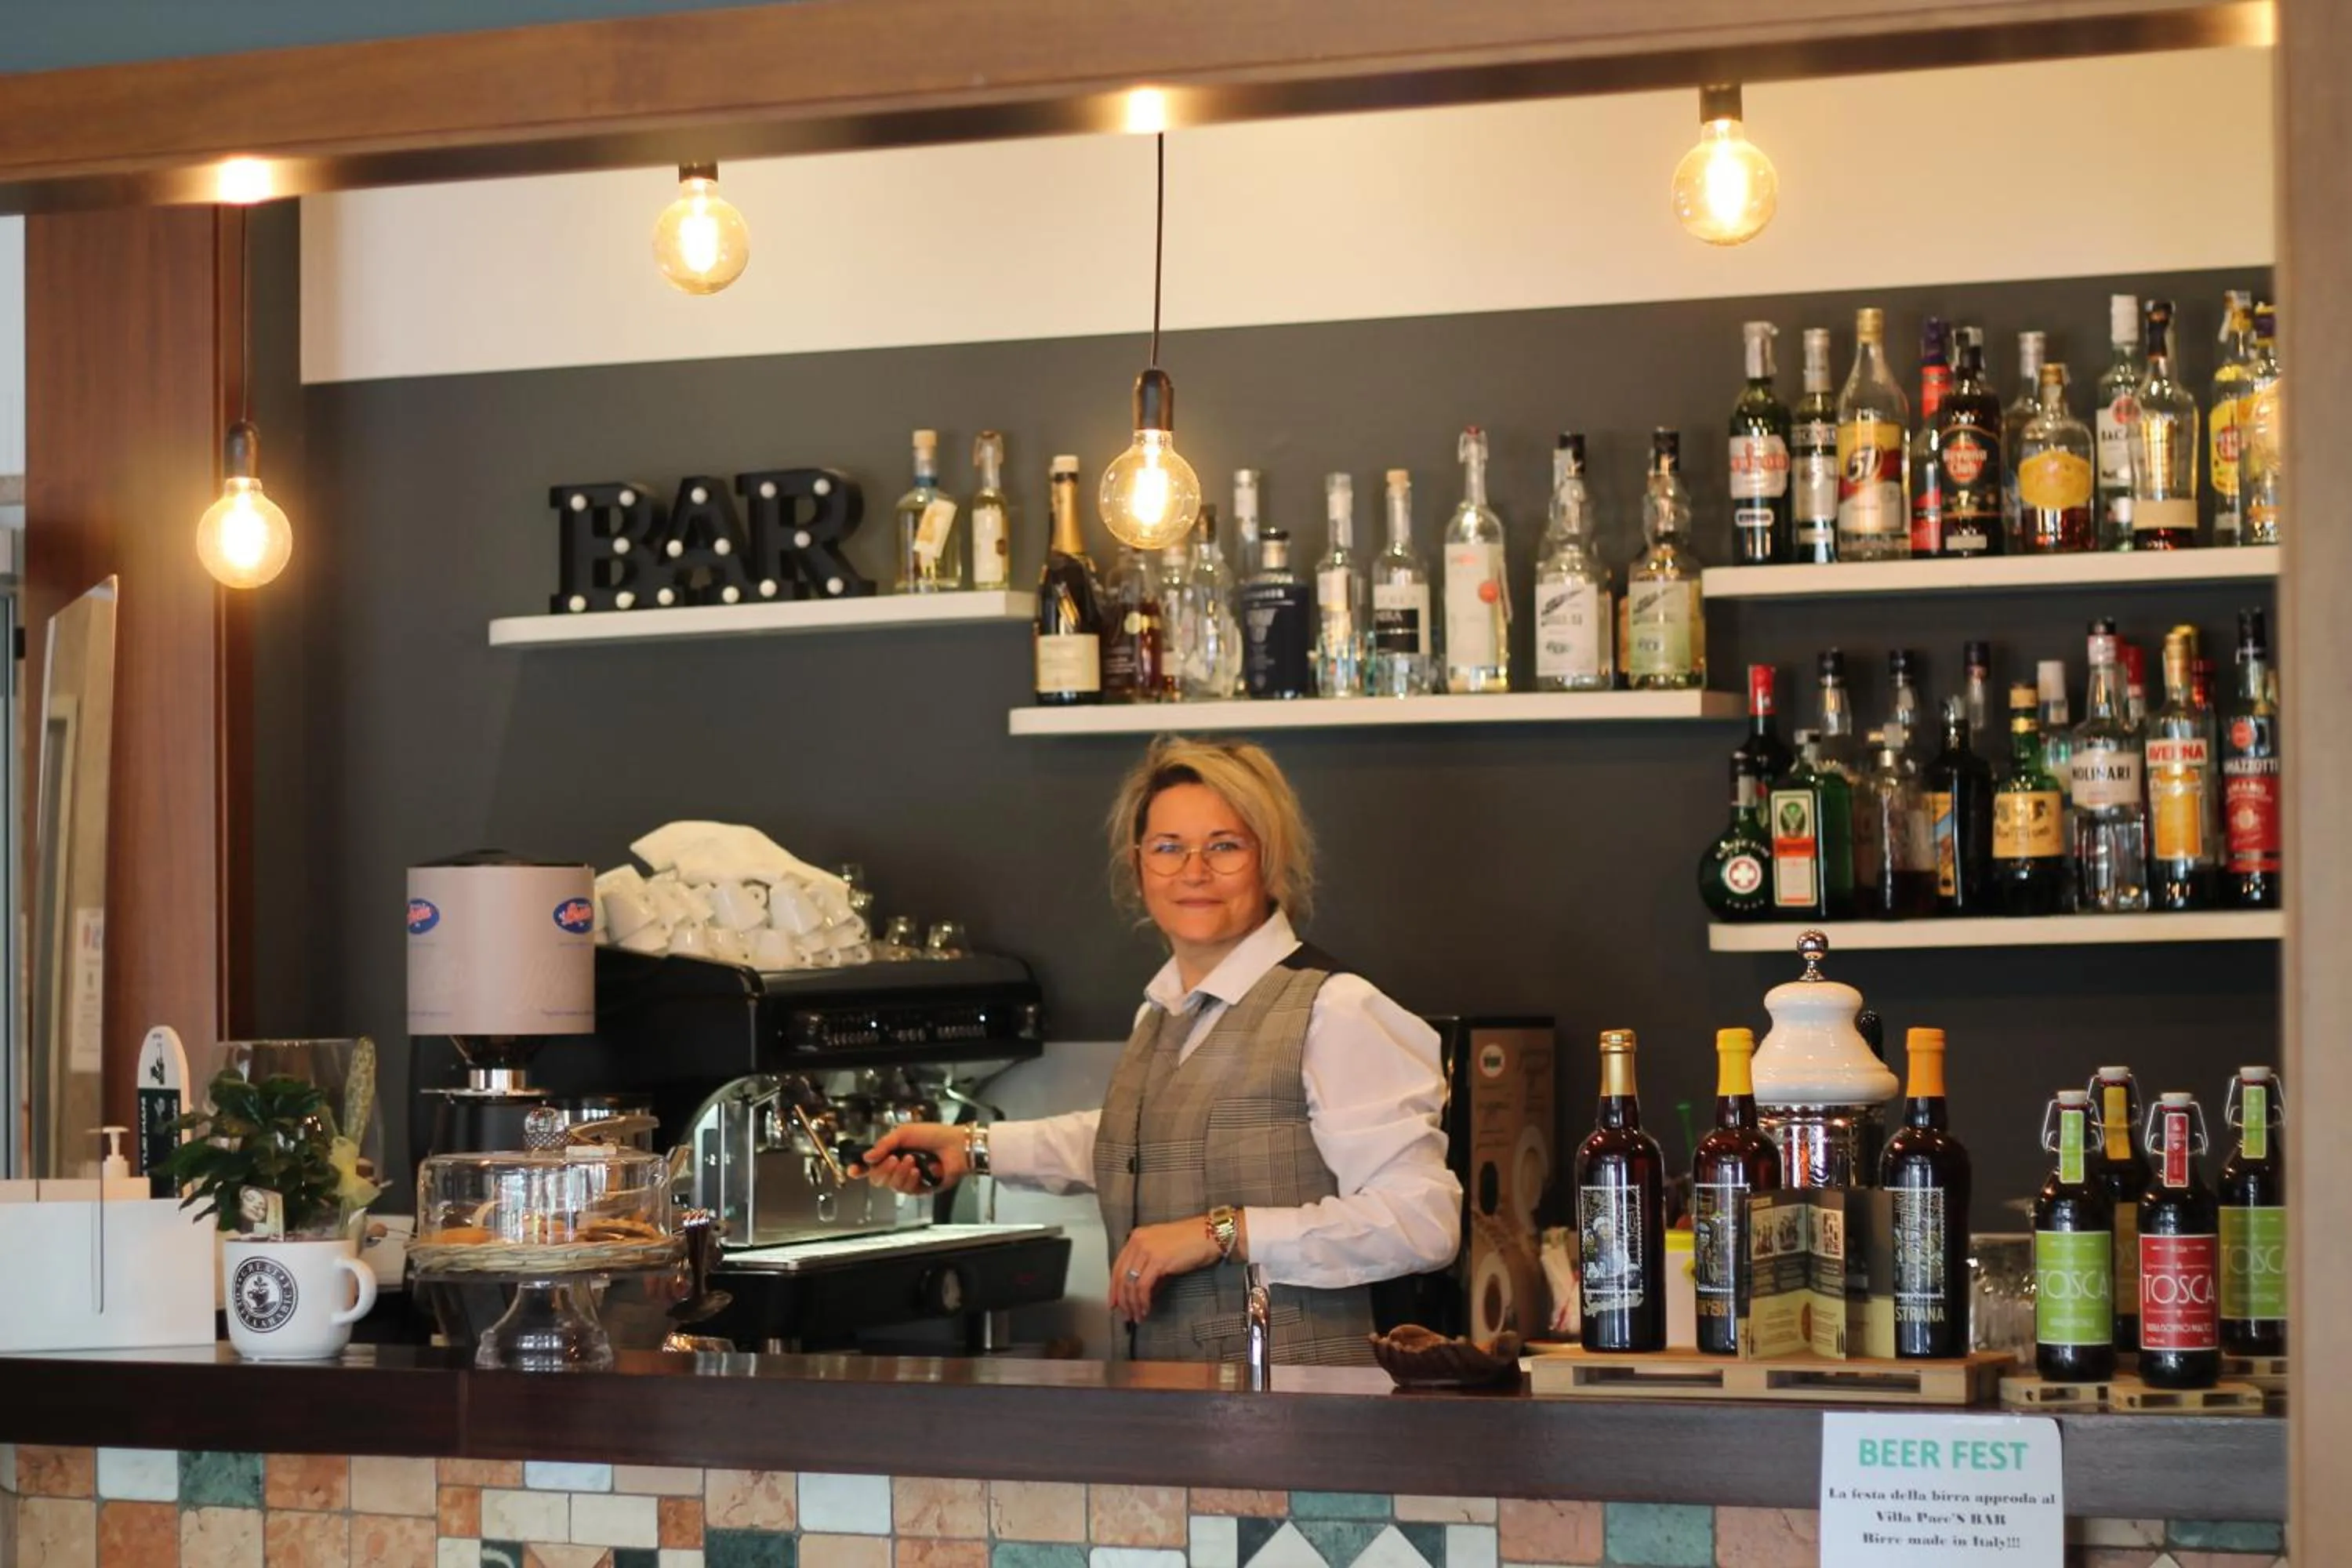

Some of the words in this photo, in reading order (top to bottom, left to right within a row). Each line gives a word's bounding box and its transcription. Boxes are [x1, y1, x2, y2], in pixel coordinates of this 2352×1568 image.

[550, 468, 877, 613] BAR
[2038, 1269, 2110, 1300] TOSCA
[2143, 1274, 2216, 1305] TOSCA
[1895, 1305, 1945, 1322] STRANA
[1859, 1438, 1941, 1469] BEER
[1951, 1440, 2029, 1471] FEST
[1829, 1488, 1846, 1499] La
[1852, 1488, 1888, 1501] festa
[1890, 1490, 1928, 1501] della
[1932, 1490, 1969, 1502] birra
[1975, 1492, 2037, 1506] approda
[2042, 1494, 2056, 1504] al
[1876, 1511, 1911, 1523] Villa
[1970, 1514, 2006, 1525] BAR
[1863, 1533, 1900, 1544] Birre
[1907, 1534, 1947, 1545] made
[1953, 1535, 1967, 1546] in
[1973, 1536, 2020, 1551] Italy!!!
